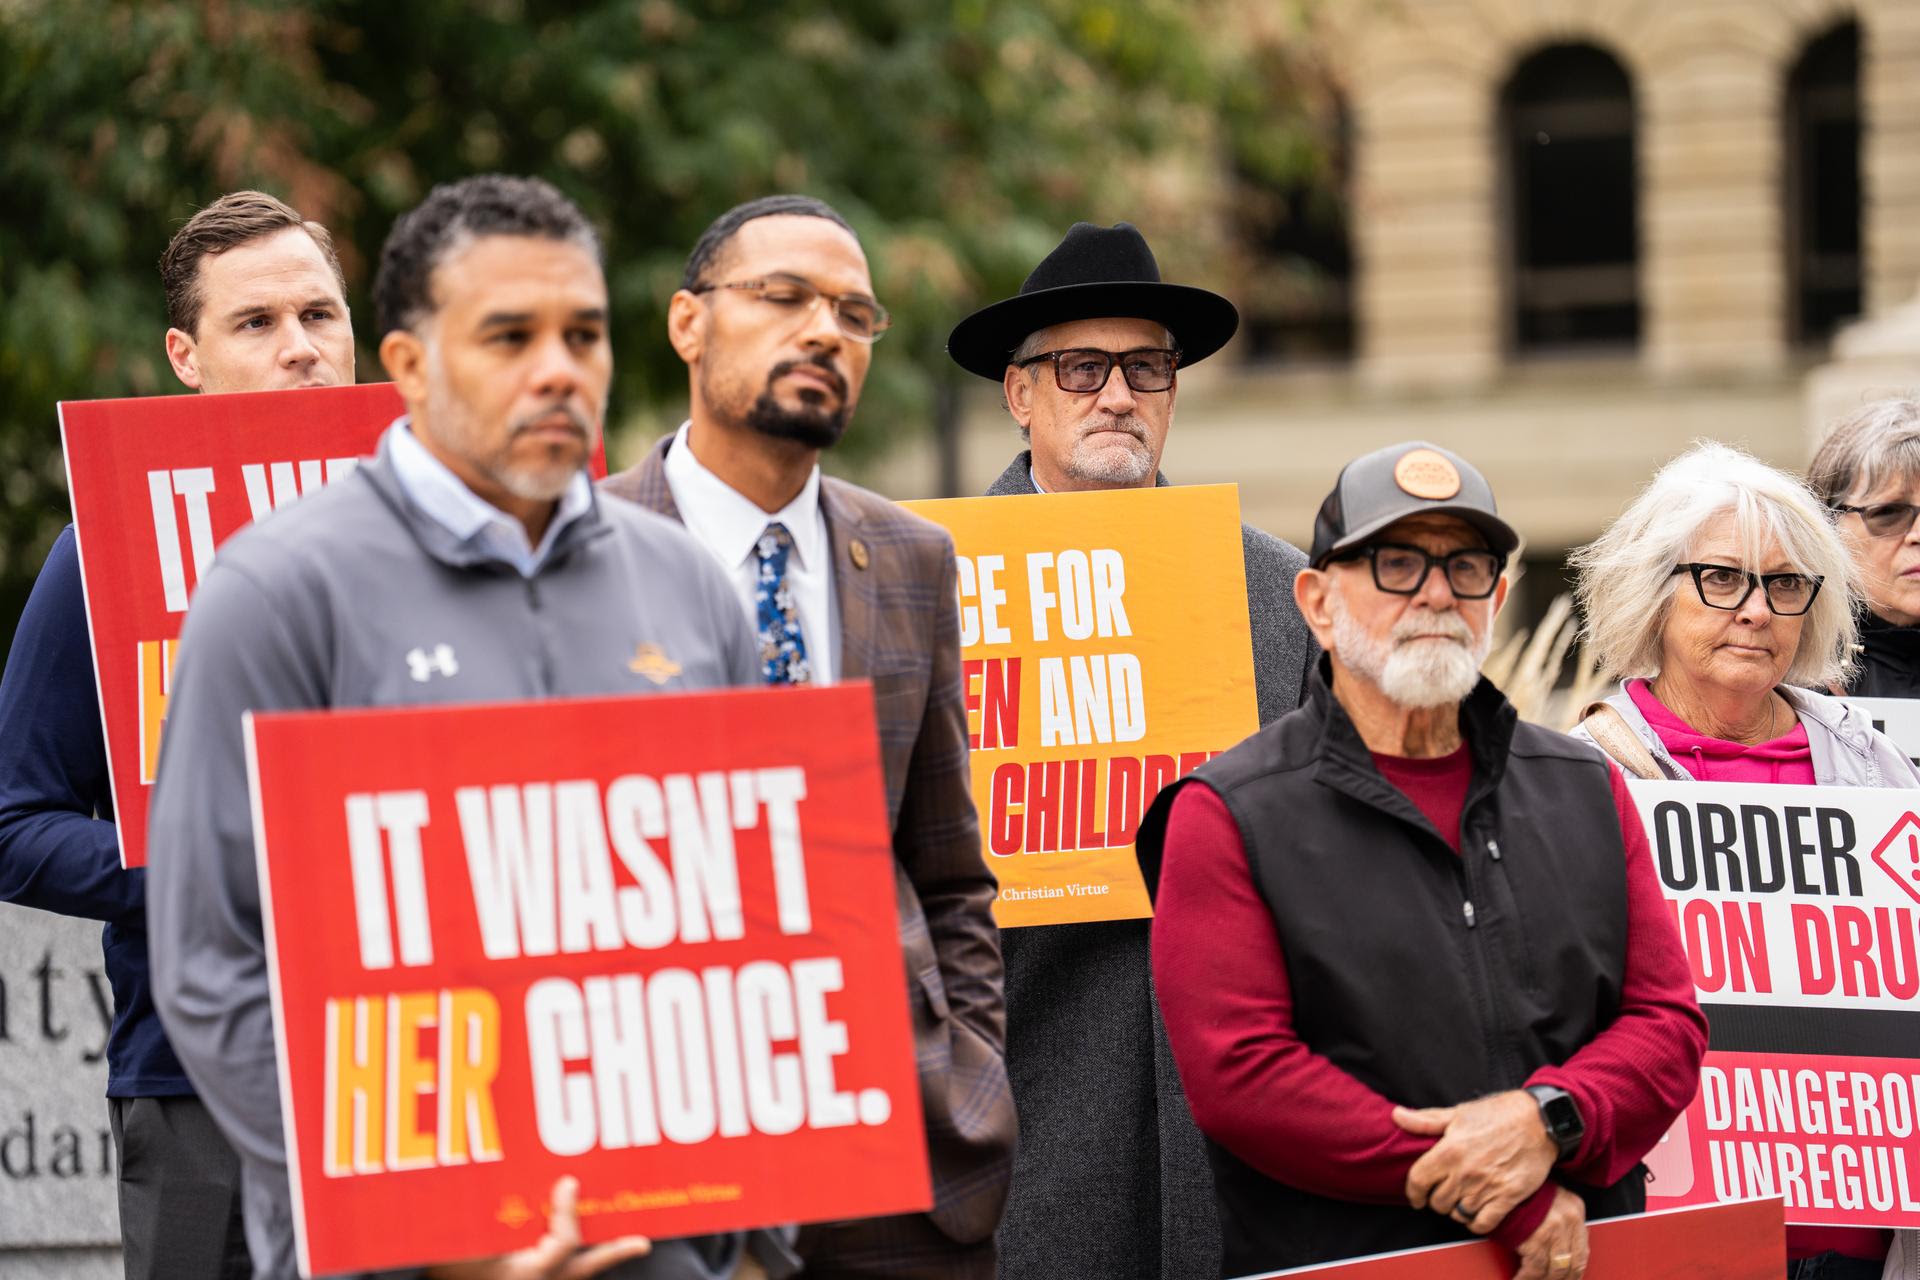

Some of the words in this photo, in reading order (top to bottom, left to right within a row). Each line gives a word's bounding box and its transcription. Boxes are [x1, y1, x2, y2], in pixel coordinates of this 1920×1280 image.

[147, 466, 216, 613] IT
[1026, 548, 1133, 641] FOR
[1039, 653, 1146, 748] AND
[987, 751, 1226, 858] CHILD
[1653, 800, 1864, 897] ORDER
[344, 790, 431, 971] IT
[455, 766, 812, 960] WASN'T
[1002, 886, 1064, 902] Christian
[1066, 883, 1110, 897] Virtue
[1790, 903, 1920, 1000] DRU
[323, 988, 505, 1179] HER
[524, 957, 892, 1157] CHOICE.
[1700, 1066, 1920, 1139] DANGERO
[1708, 1140, 1920, 1212] UNREGUL
